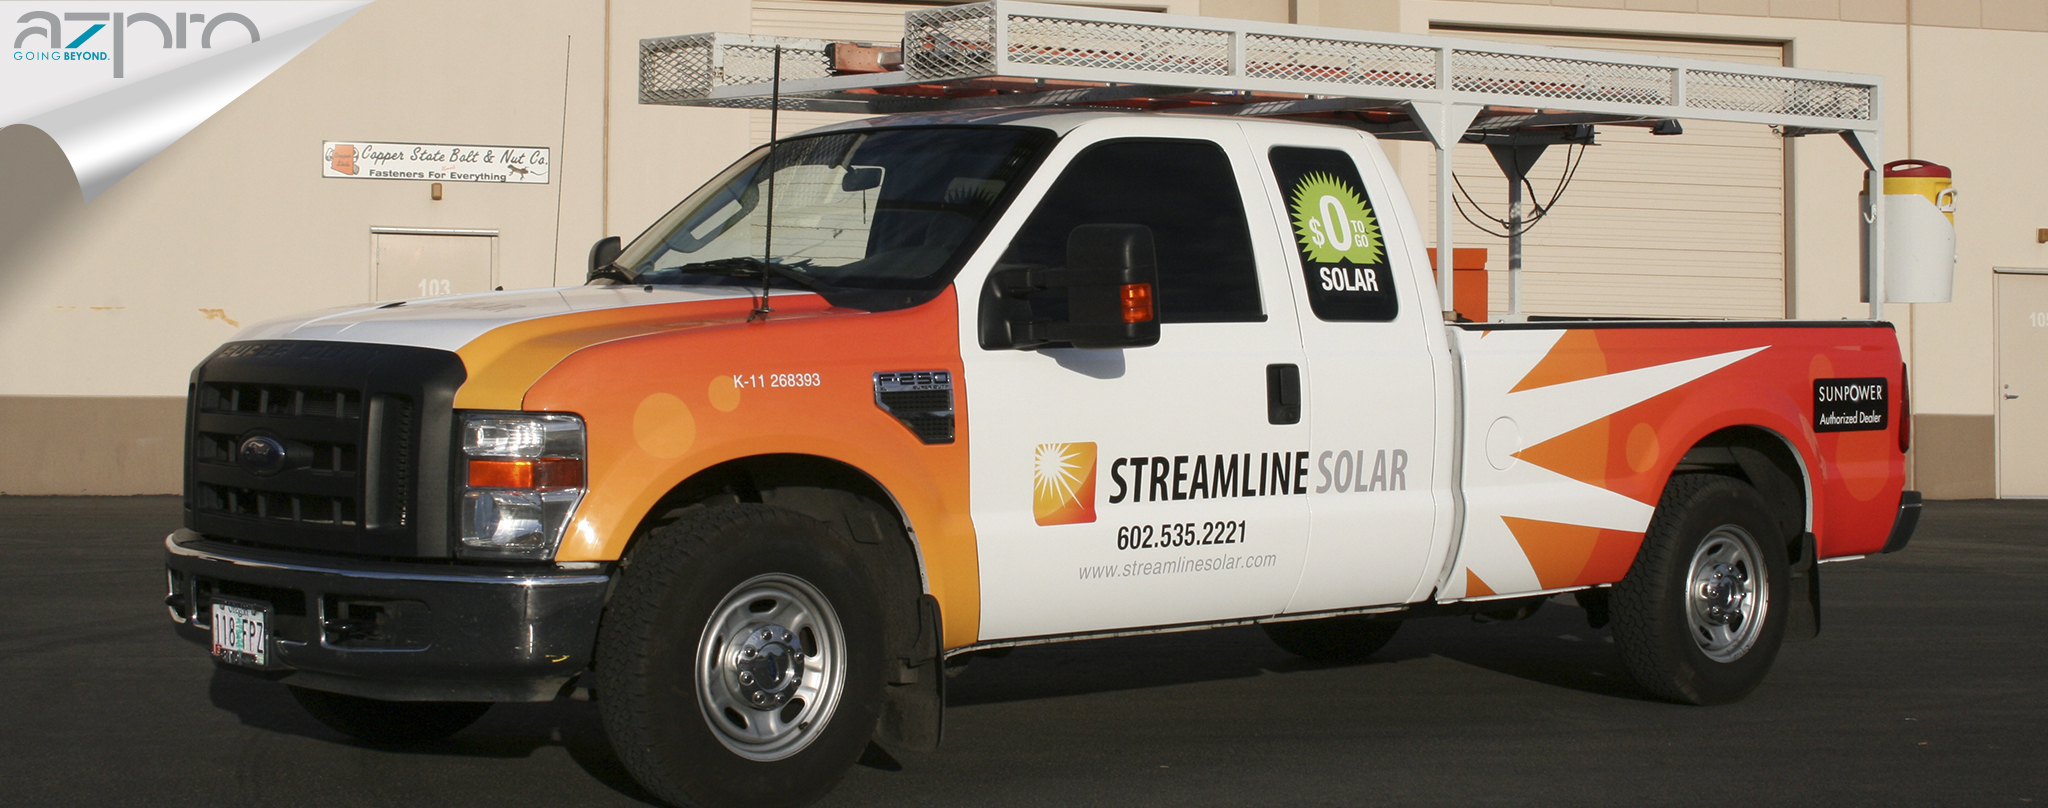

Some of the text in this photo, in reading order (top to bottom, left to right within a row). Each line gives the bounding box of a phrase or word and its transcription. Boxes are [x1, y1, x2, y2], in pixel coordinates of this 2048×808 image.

[361, 145, 404, 165] Copper
[410, 146, 446, 162] State
[449, 148, 479, 163] Bolt
[483, 149, 495, 164] &
[500, 149, 525, 164] Nut
[529, 150, 548, 165] Co.
[369, 169, 507, 183] Fasteners For Everything
[1350, 220, 1365, 234] TO
[1354, 234, 1369, 248] GO
[418, 278, 450, 297] 103
[1319, 266, 1379, 292] SOLAR
[2029, 311, 2048, 328] 10
[733, 373, 821, 389] K-11 268393
[879, 372, 949, 386] F-250
[1819, 384, 1883, 402] SUNPOWER
[1819, 409, 1882, 425] Authorized Dealer
[1108, 448, 1409, 504] STREAMLINE SOLAR
[1117, 520, 1247, 550] 602.535.2221
[1078, 552, 1277, 580] www.streamlinesolar.com
[215, 613, 264, 653] 118 FPZ
